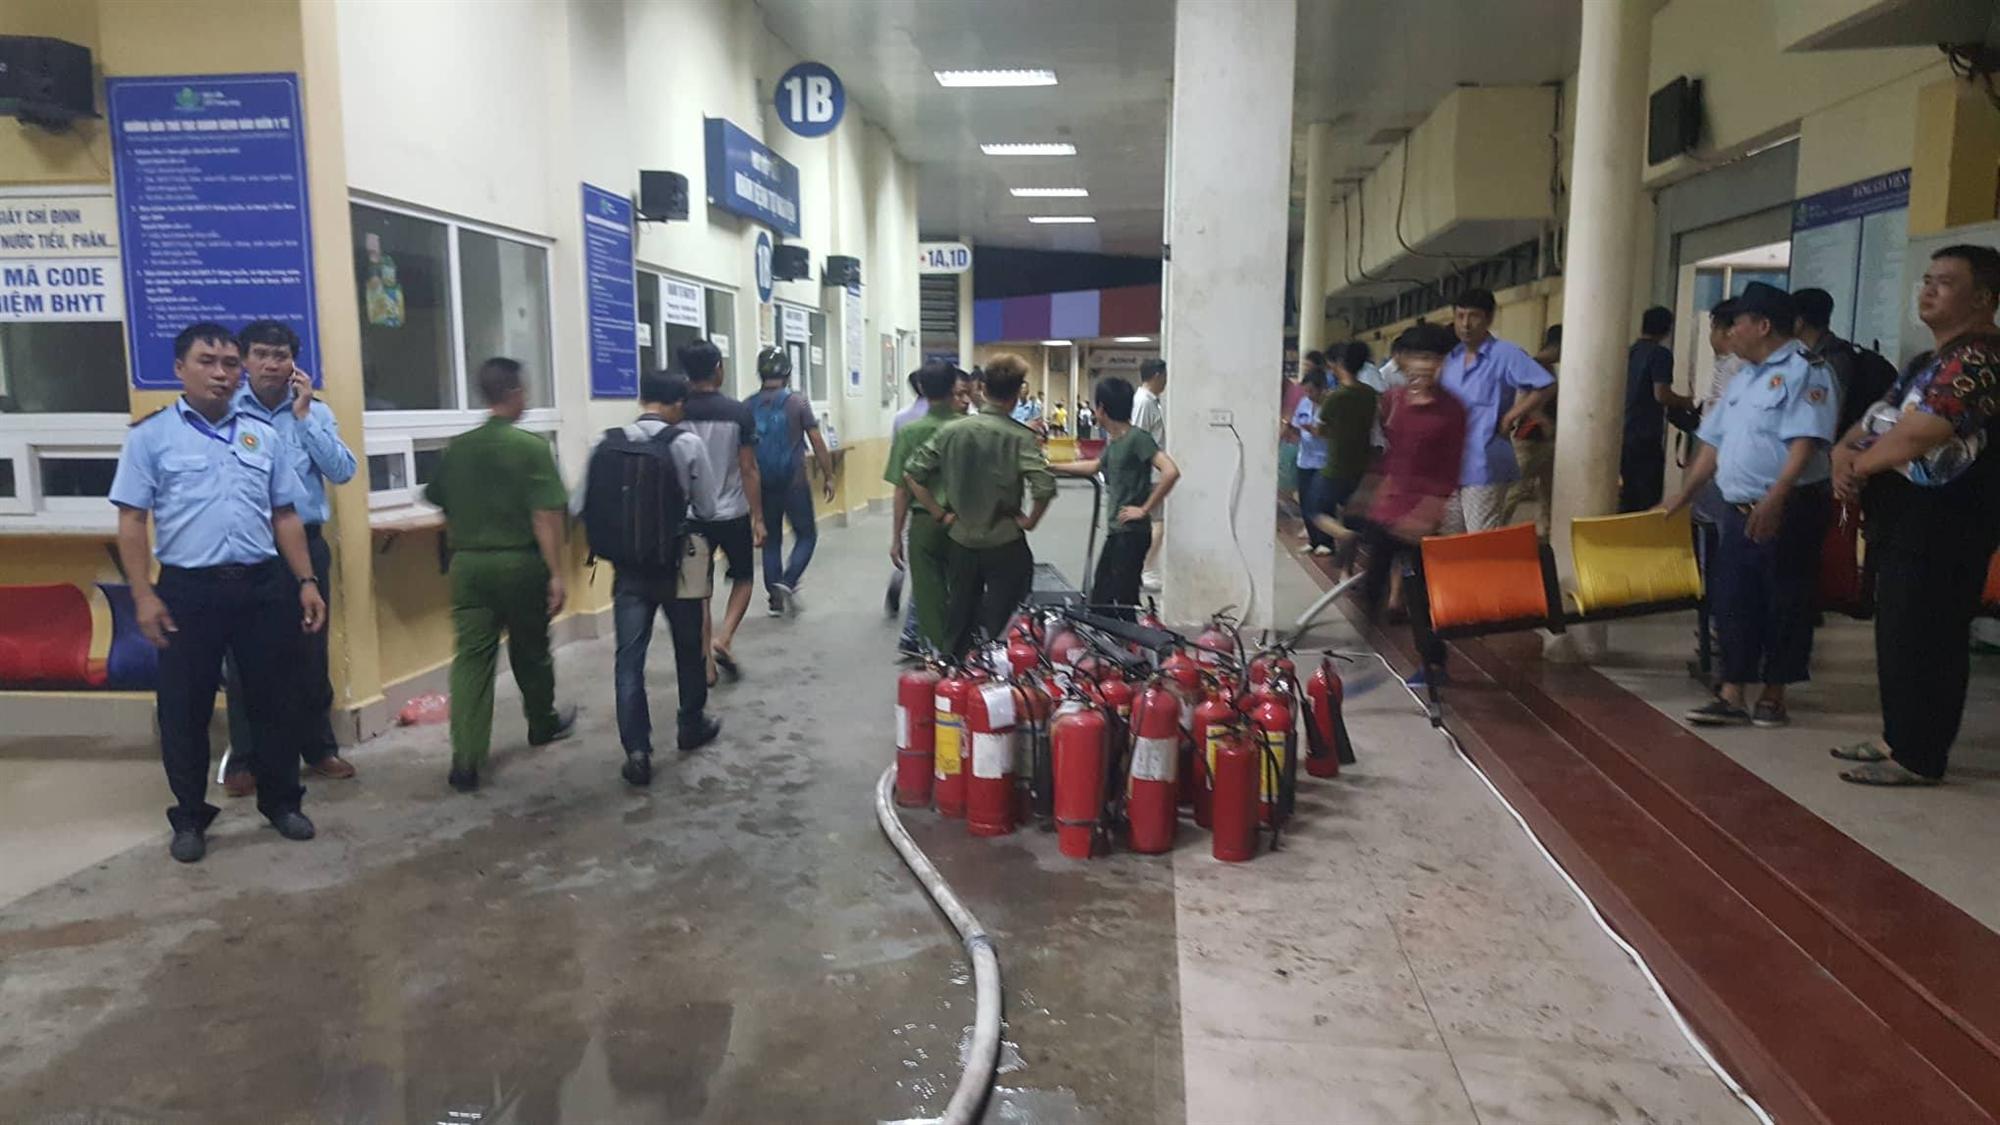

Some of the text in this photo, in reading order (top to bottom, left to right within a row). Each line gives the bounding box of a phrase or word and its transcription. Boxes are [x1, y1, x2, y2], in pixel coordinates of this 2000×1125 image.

[785, 76, 834, 123] 1B
[4, 264, 105, 287] MÃ CODE
[0, 290, 105, 318] IỆM BHYT
